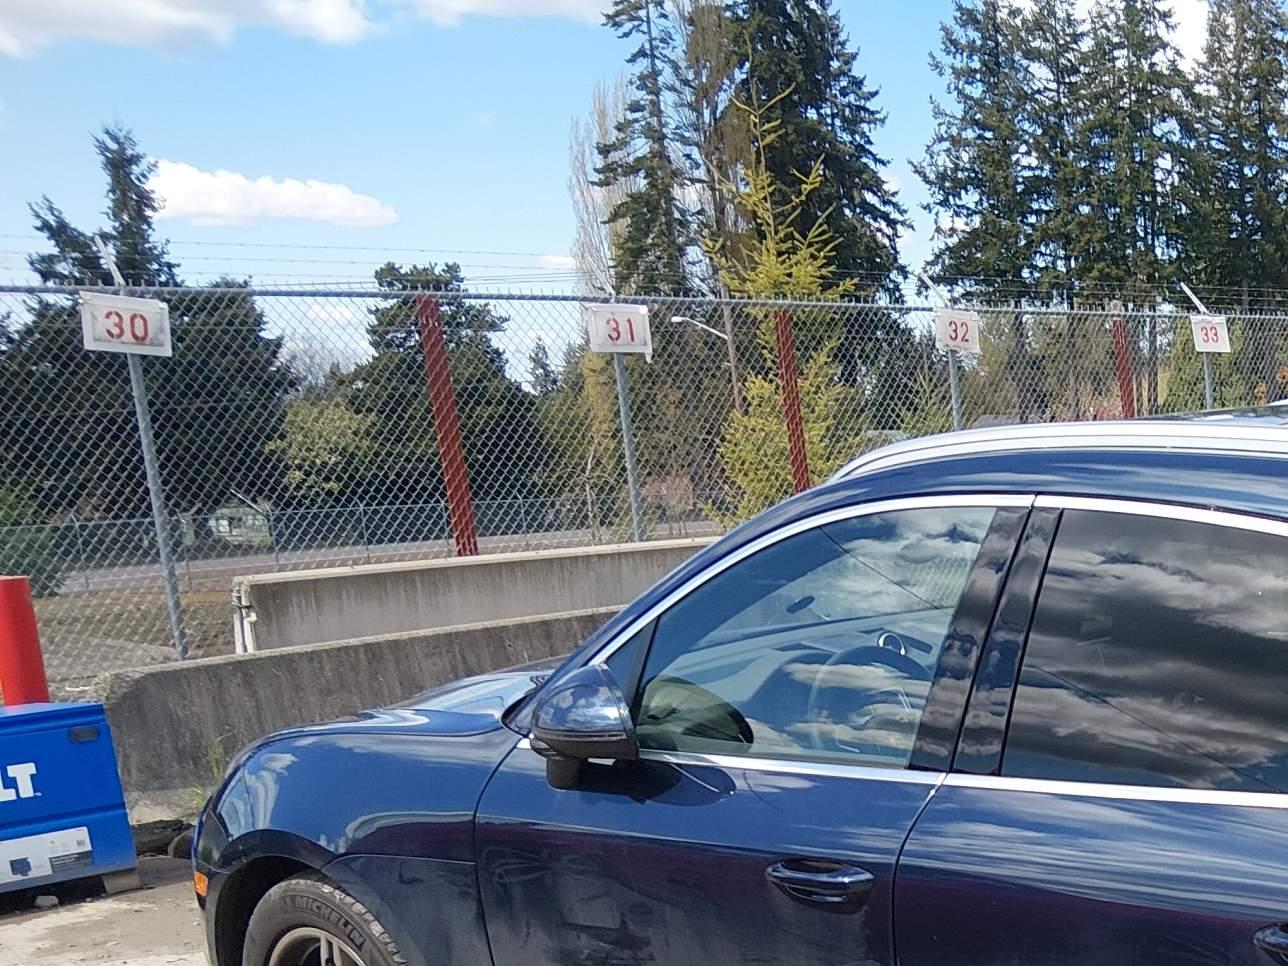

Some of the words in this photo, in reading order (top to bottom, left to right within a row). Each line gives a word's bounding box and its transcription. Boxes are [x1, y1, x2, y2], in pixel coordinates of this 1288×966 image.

[105, 310, 149, 343] 30
[606, 317, 635, 342] 31
[949, 320, 969, 342] 32
[1201, 326, 1219, 343] 33
